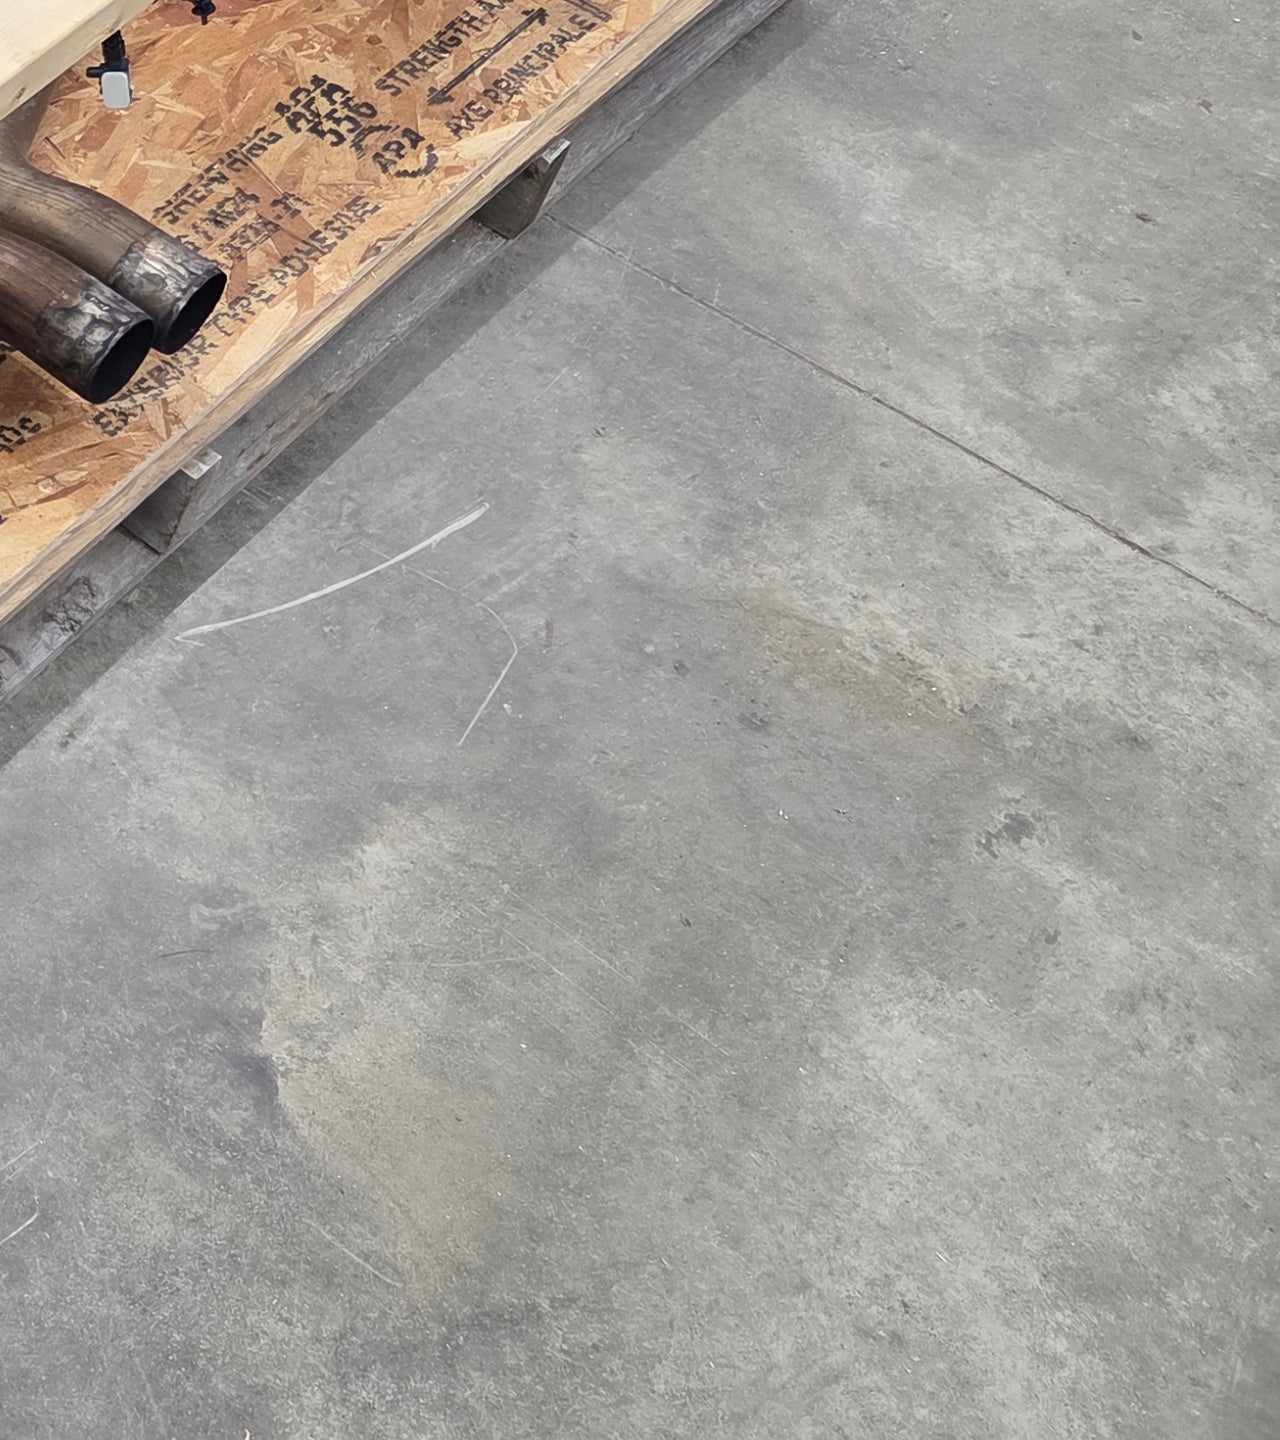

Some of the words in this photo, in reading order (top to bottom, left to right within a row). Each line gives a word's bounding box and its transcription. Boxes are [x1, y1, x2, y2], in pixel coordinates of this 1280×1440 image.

[372, 11, 487, 99] STRENGTH
[443, 100, 493, 135] AXE
[479, 13, 597, 104] PRINCIPALE
[369, 127, 426, 168] APA
